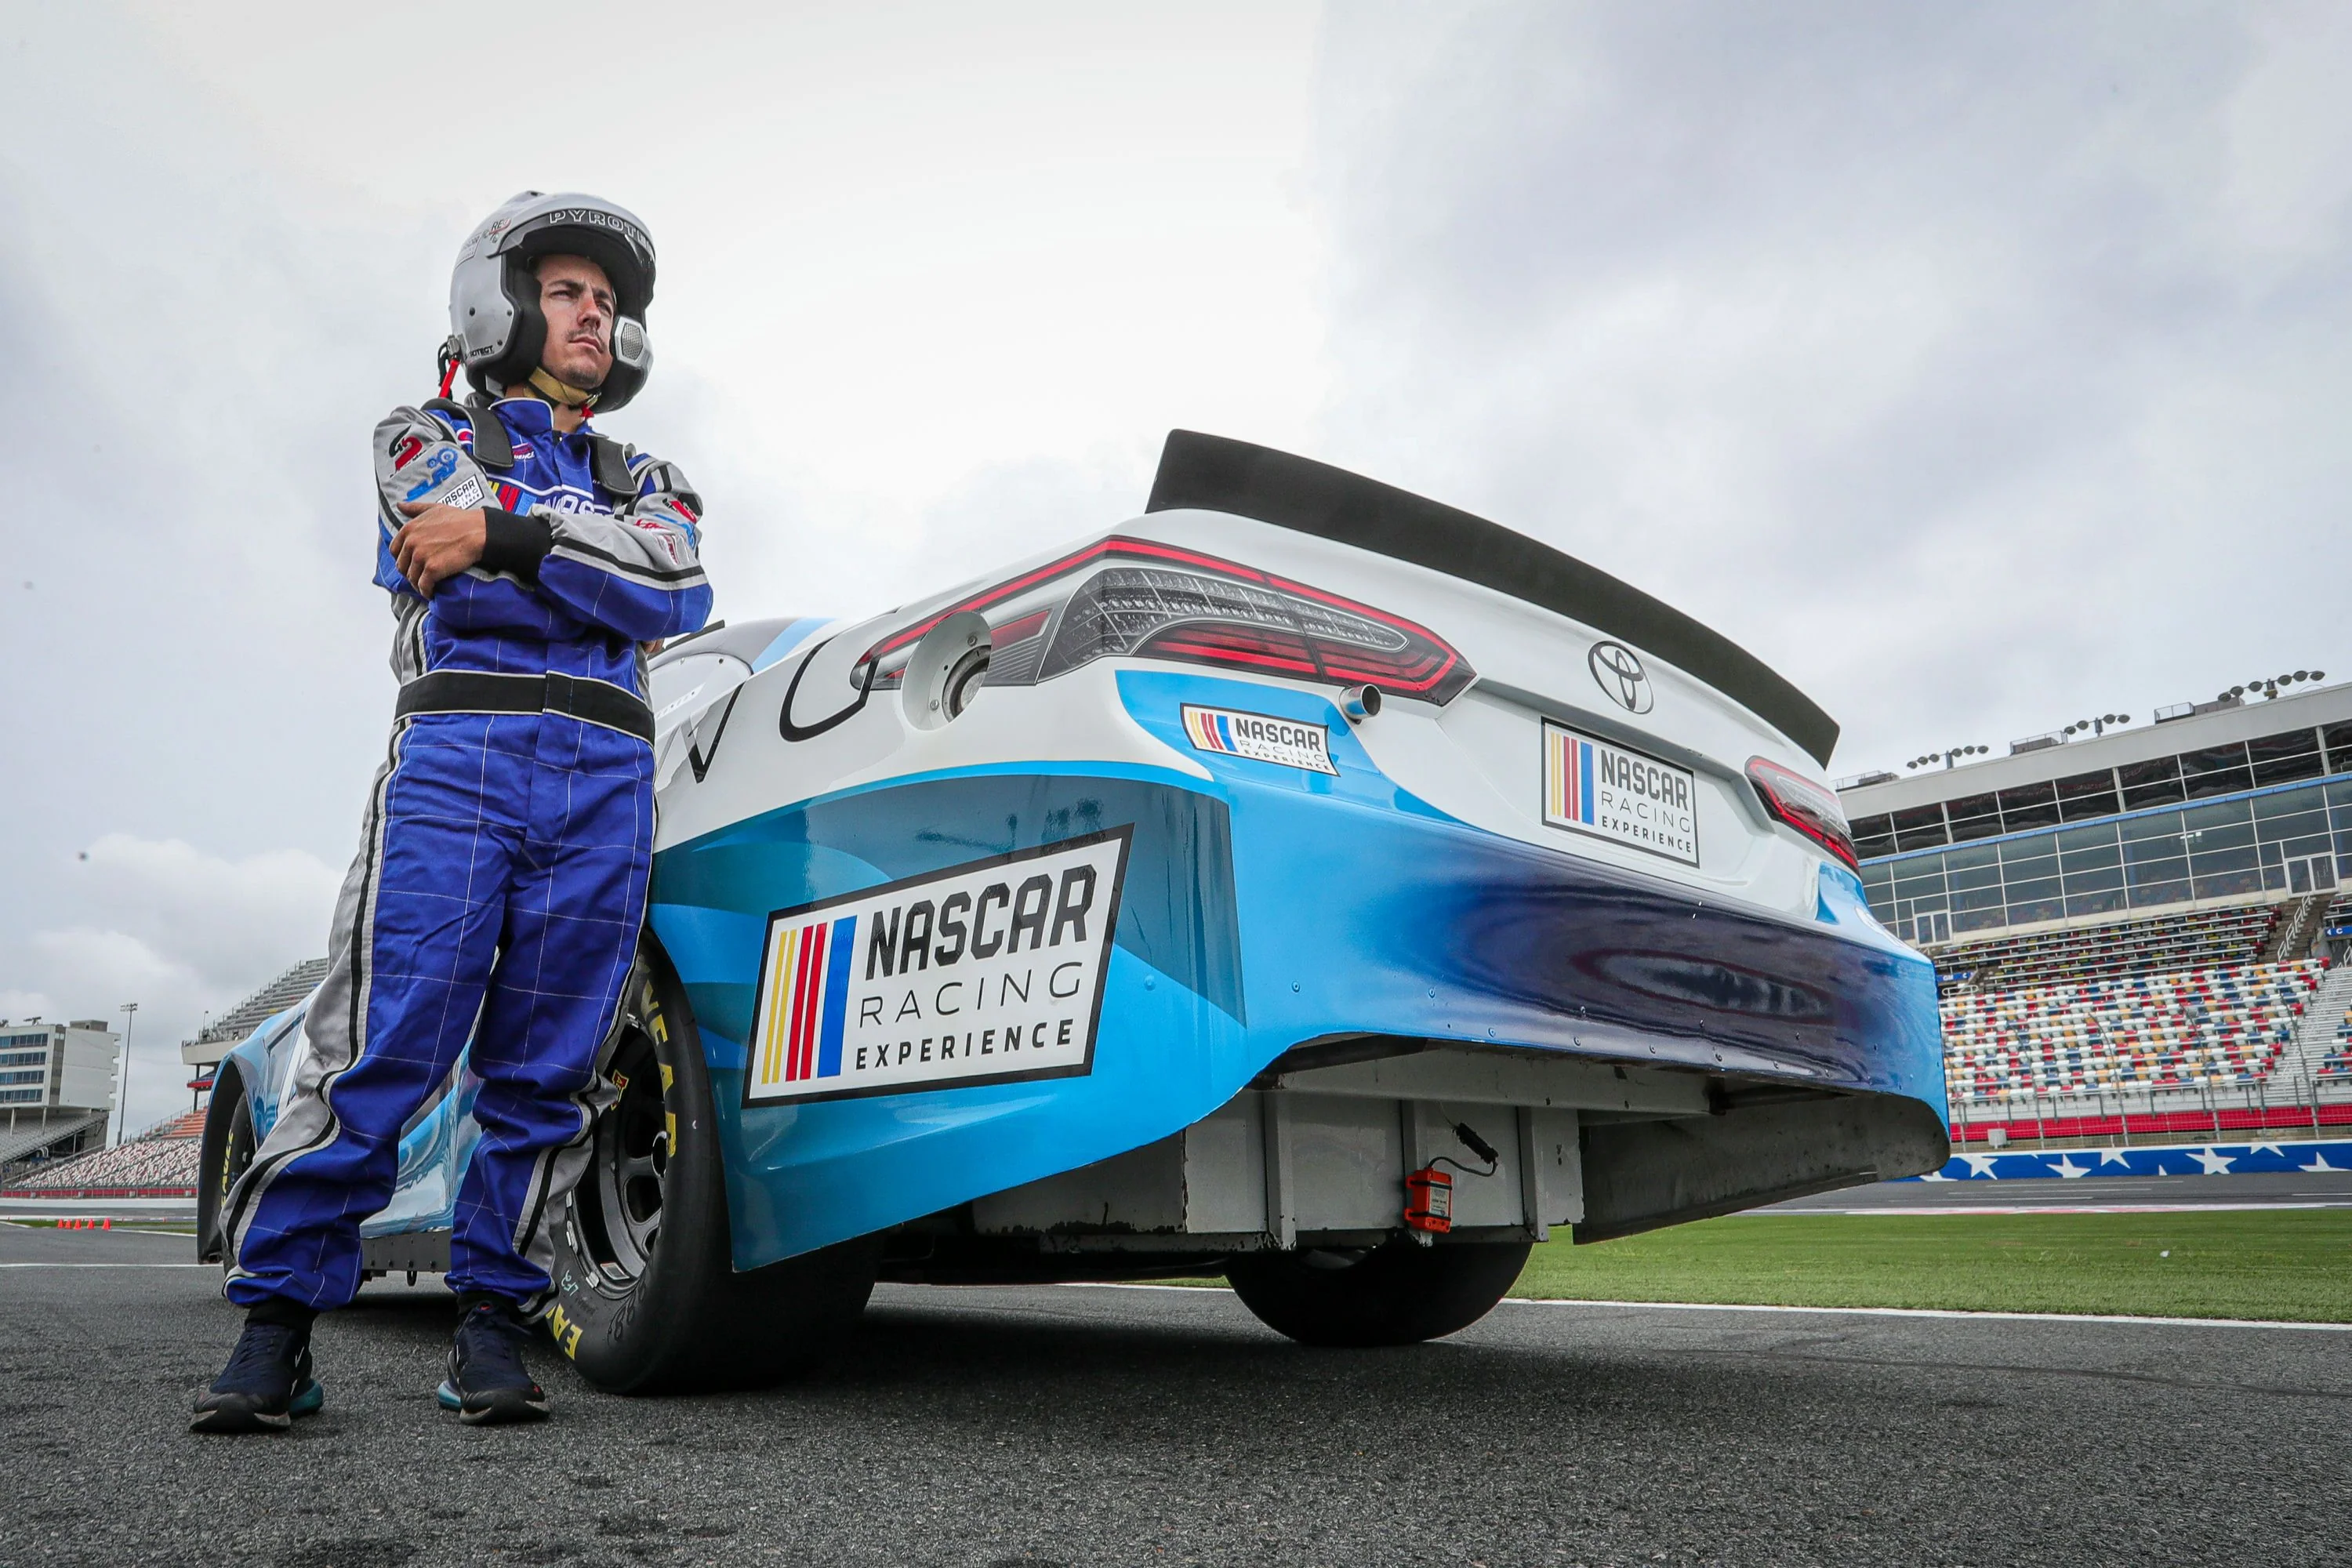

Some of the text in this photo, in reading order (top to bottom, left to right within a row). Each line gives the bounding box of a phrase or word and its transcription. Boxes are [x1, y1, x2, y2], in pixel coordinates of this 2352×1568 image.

[1236, 717, 1321, 752] NASCAR
[1239, 739, 1326, 763] RACING
[1244, 750, 1330, 771] EXPERIENCE
[1601, 749, 1689, 811] NASCAR
[1601, 790, 1690, 833] RACING
[1602, 815, 1692, 853] EXPERIENCE
[866, 864, 1098, 982] NASCAR
[859, 962, 1083, 1029] RACING
[855, 1018, 1074, 1070] EXPERIENCE
